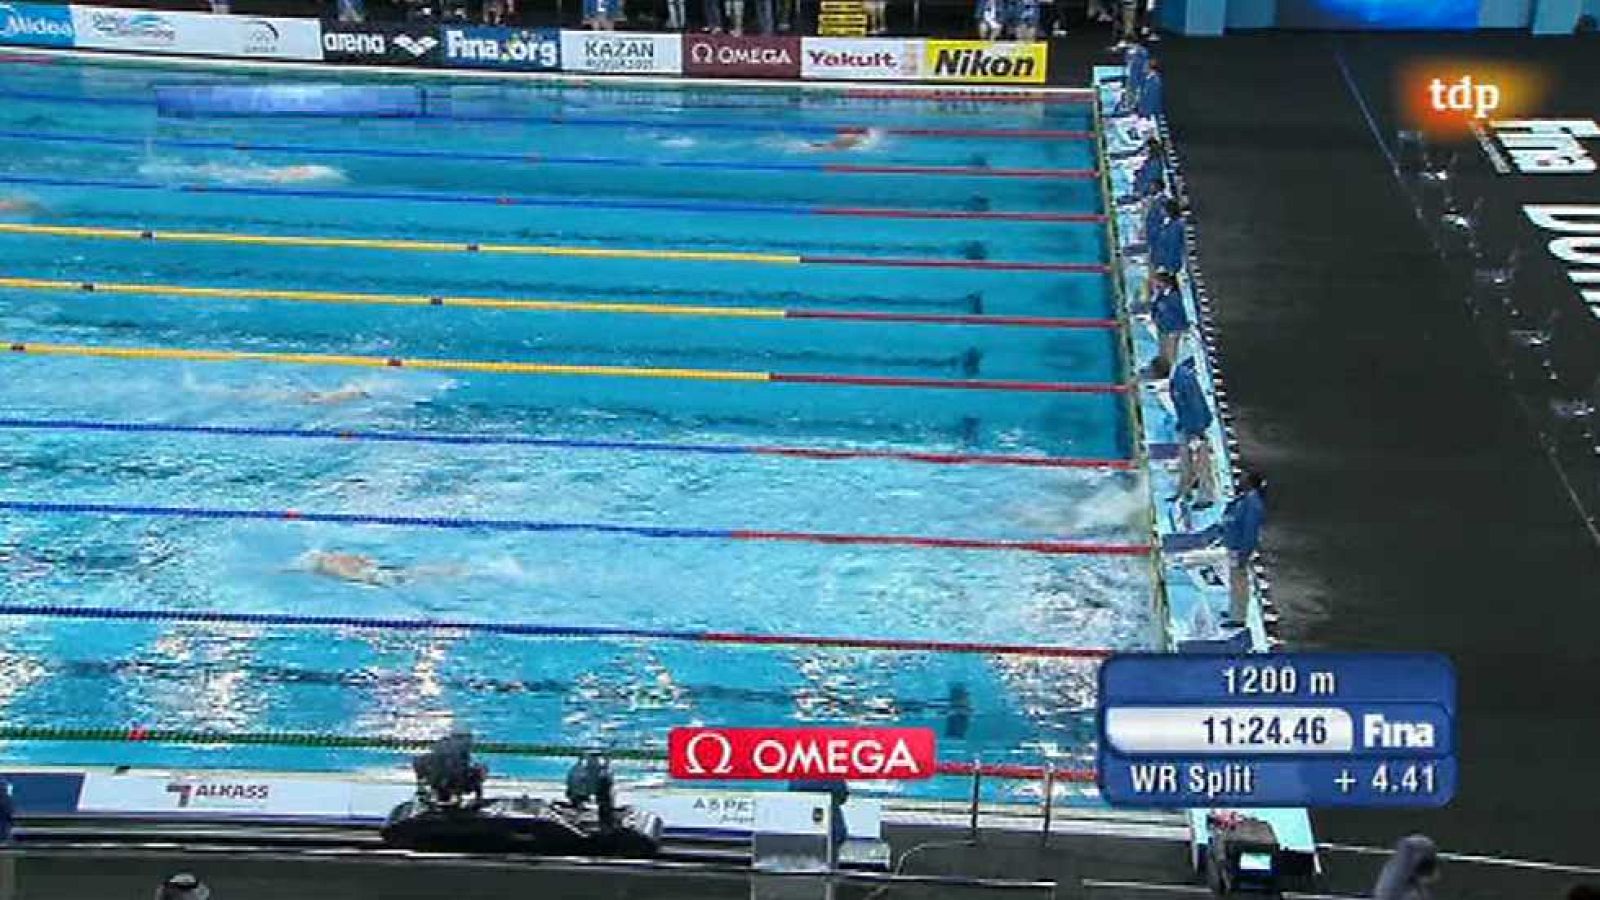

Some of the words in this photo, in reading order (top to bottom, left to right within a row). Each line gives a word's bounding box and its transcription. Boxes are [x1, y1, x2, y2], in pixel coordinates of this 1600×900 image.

[324, 32, 386, 54] arena
[446, 29, 557, 67] Fina.org
[585, 39, 654, 58] KAZAN
[718, 45, 792, 64] OMEGA
[807, 50, 894, 69] Yakult
[934, 48, 1036, 77] Nikon
